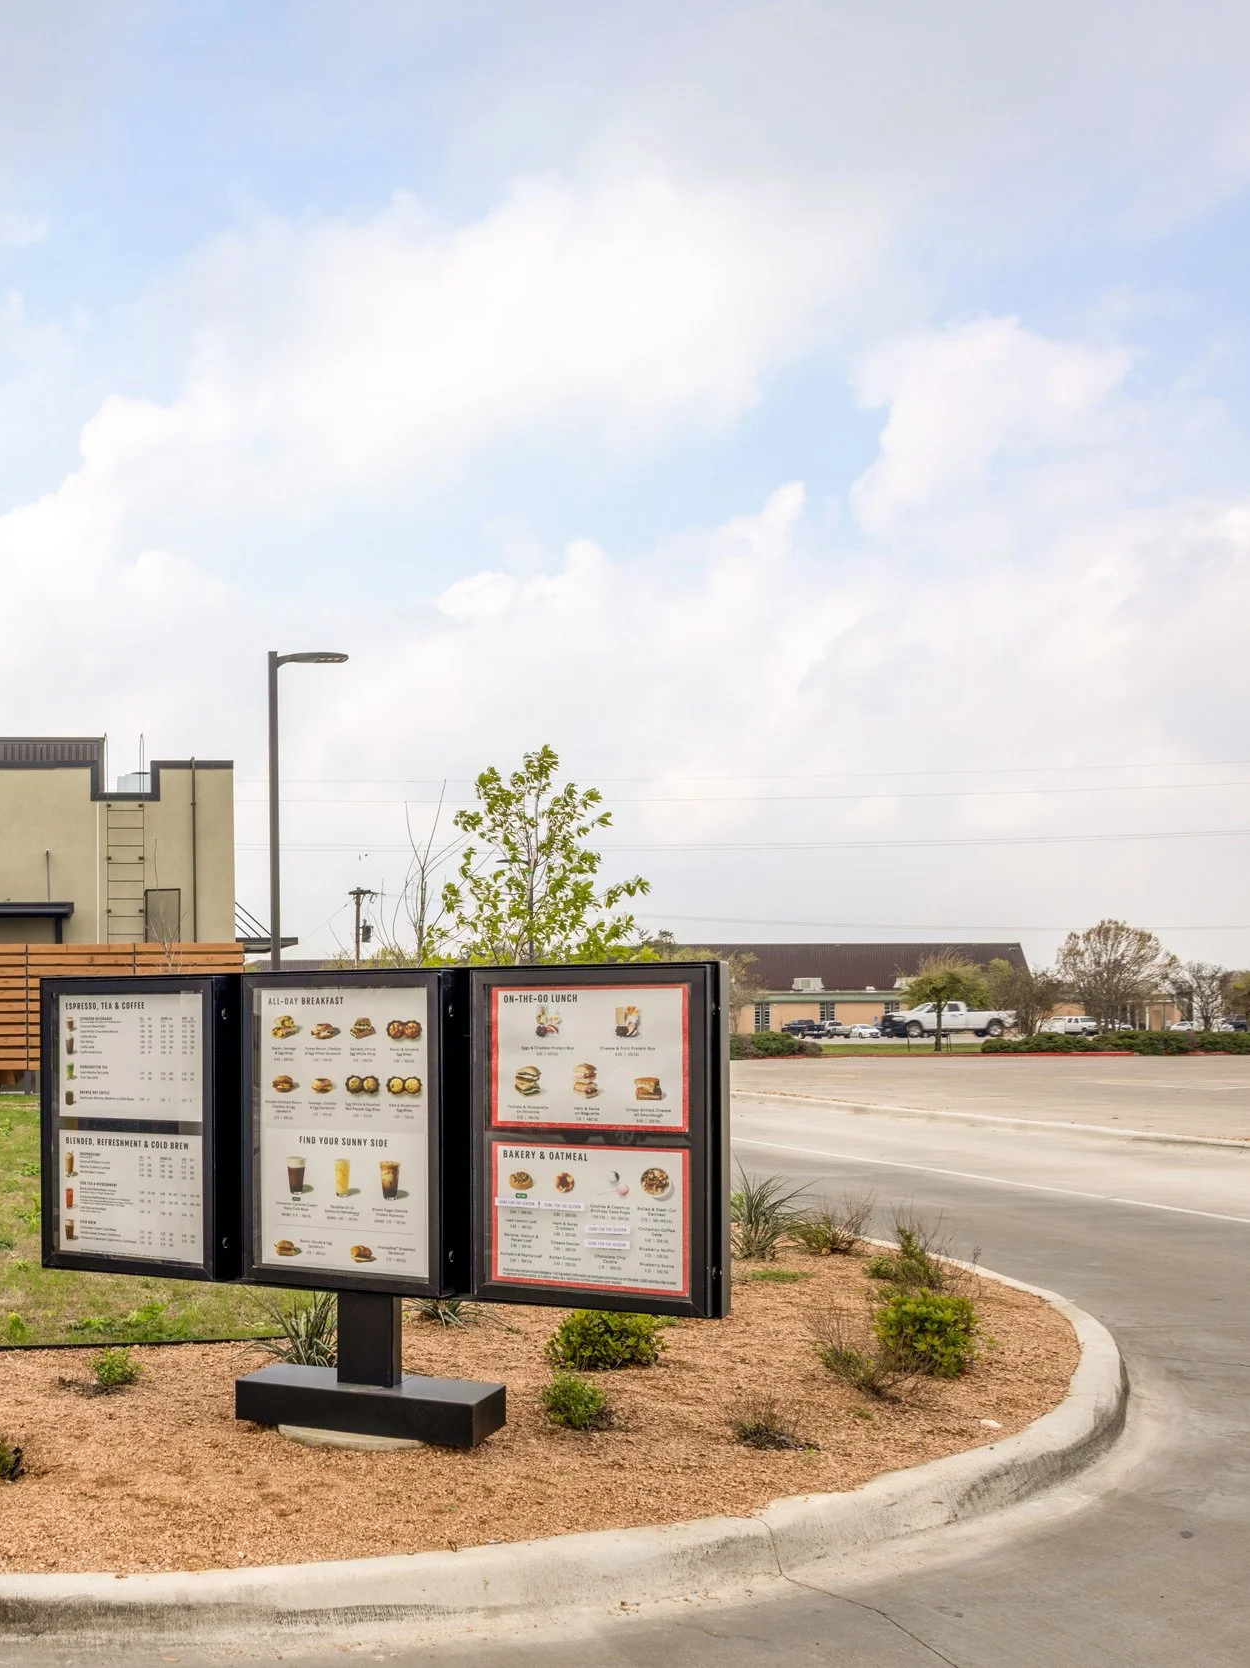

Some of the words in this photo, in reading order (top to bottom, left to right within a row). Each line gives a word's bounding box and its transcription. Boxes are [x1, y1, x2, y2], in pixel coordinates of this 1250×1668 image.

[268, 997, 298, 1005] ALL-DAY
[301, 996, 344, 1005] BREAKFAST
[503, 994, 548, 1003] ON-THE-GO
[551, 994, 578, 1003] LUNCH
[66, 1002, 99, 1010] ESPRESSO,
[66, 1136, 94, 1146] BLENDED,
[97, 1138, 142, 1148] REFRESHMENT
[151, 1141, 168, 1149] COLD
[299, 1136, 316, 1144] FIND
[319, 1137, 339, 1145] YOUR
[342, 1138, 368, 1146] SUNNY
[371, 1139, 388, 1148] SIDE
[503, 1150, 536, 1160] BAKERY
[540, 1151, 545, 1160] &
[549, 1152, 588, 1161] OATMEAL
